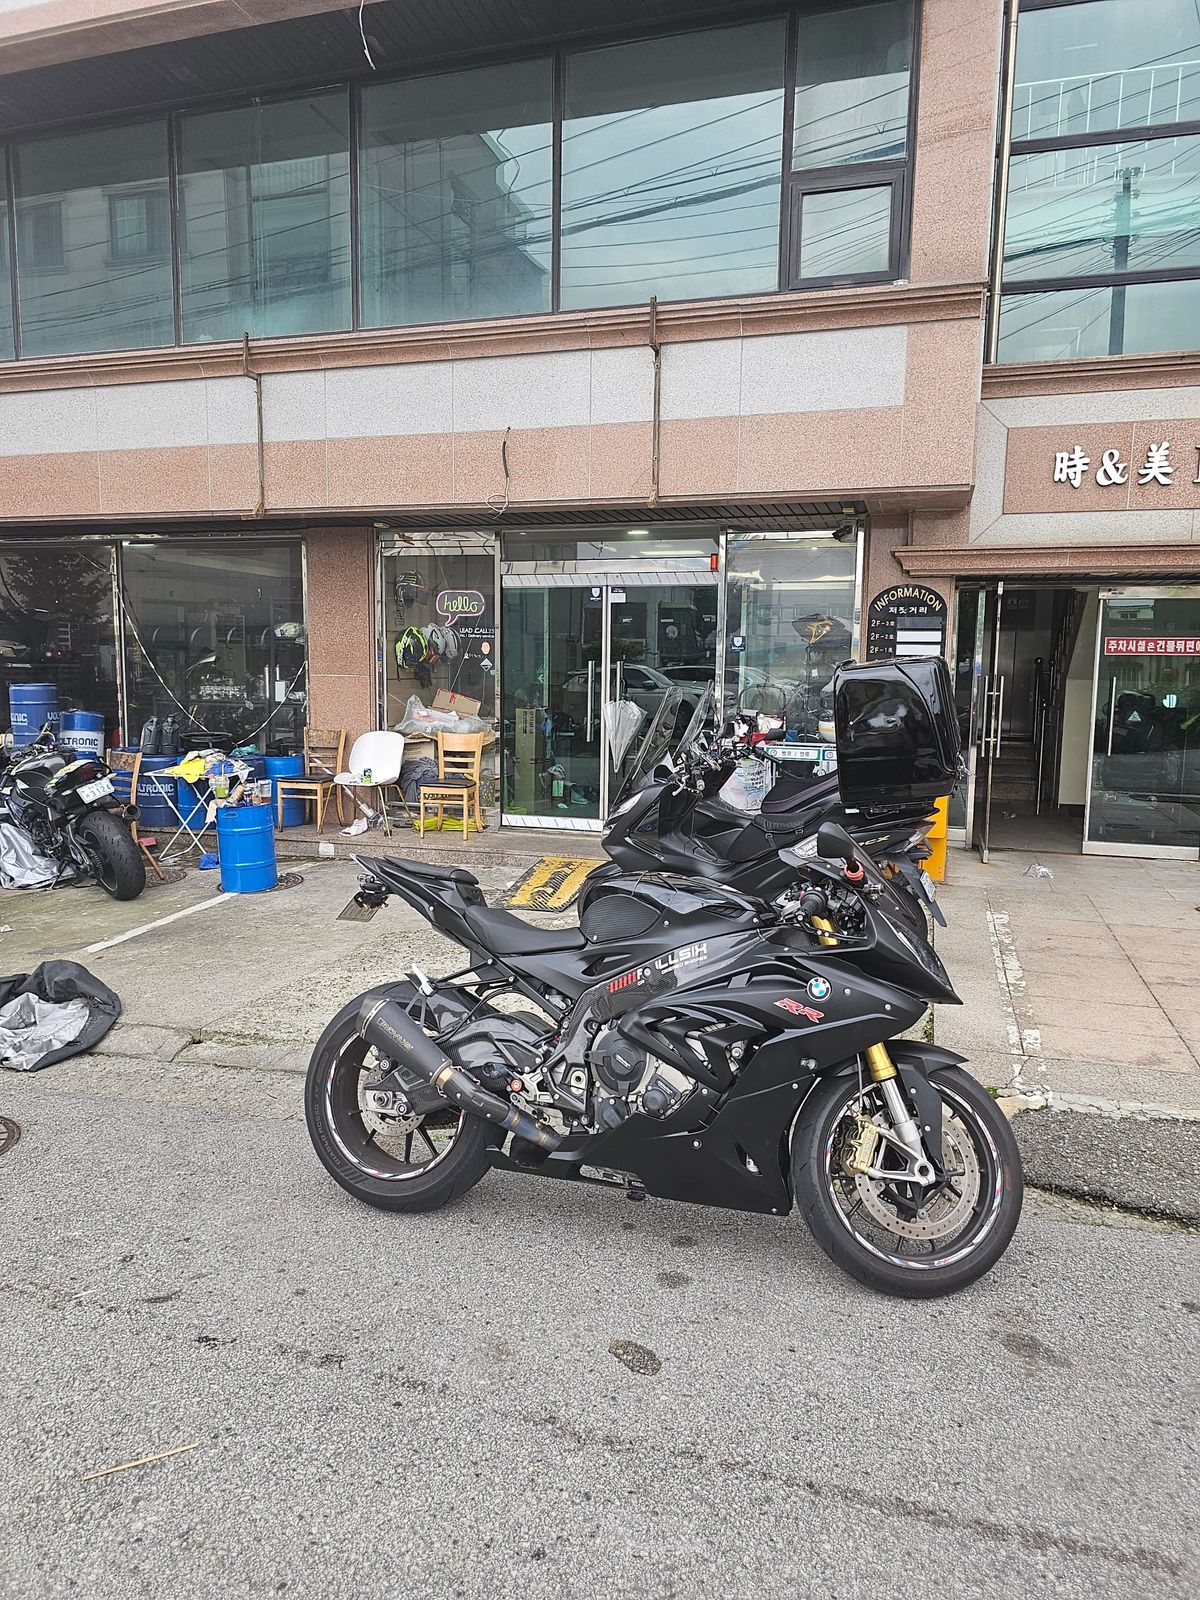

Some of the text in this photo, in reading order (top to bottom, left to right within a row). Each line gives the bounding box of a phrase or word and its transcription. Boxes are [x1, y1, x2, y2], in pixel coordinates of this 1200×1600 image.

[443, 594, 478, 613] hello
[874, 587, 942, 612] INFORMATION
[773, 997, 825, 1024] RR
